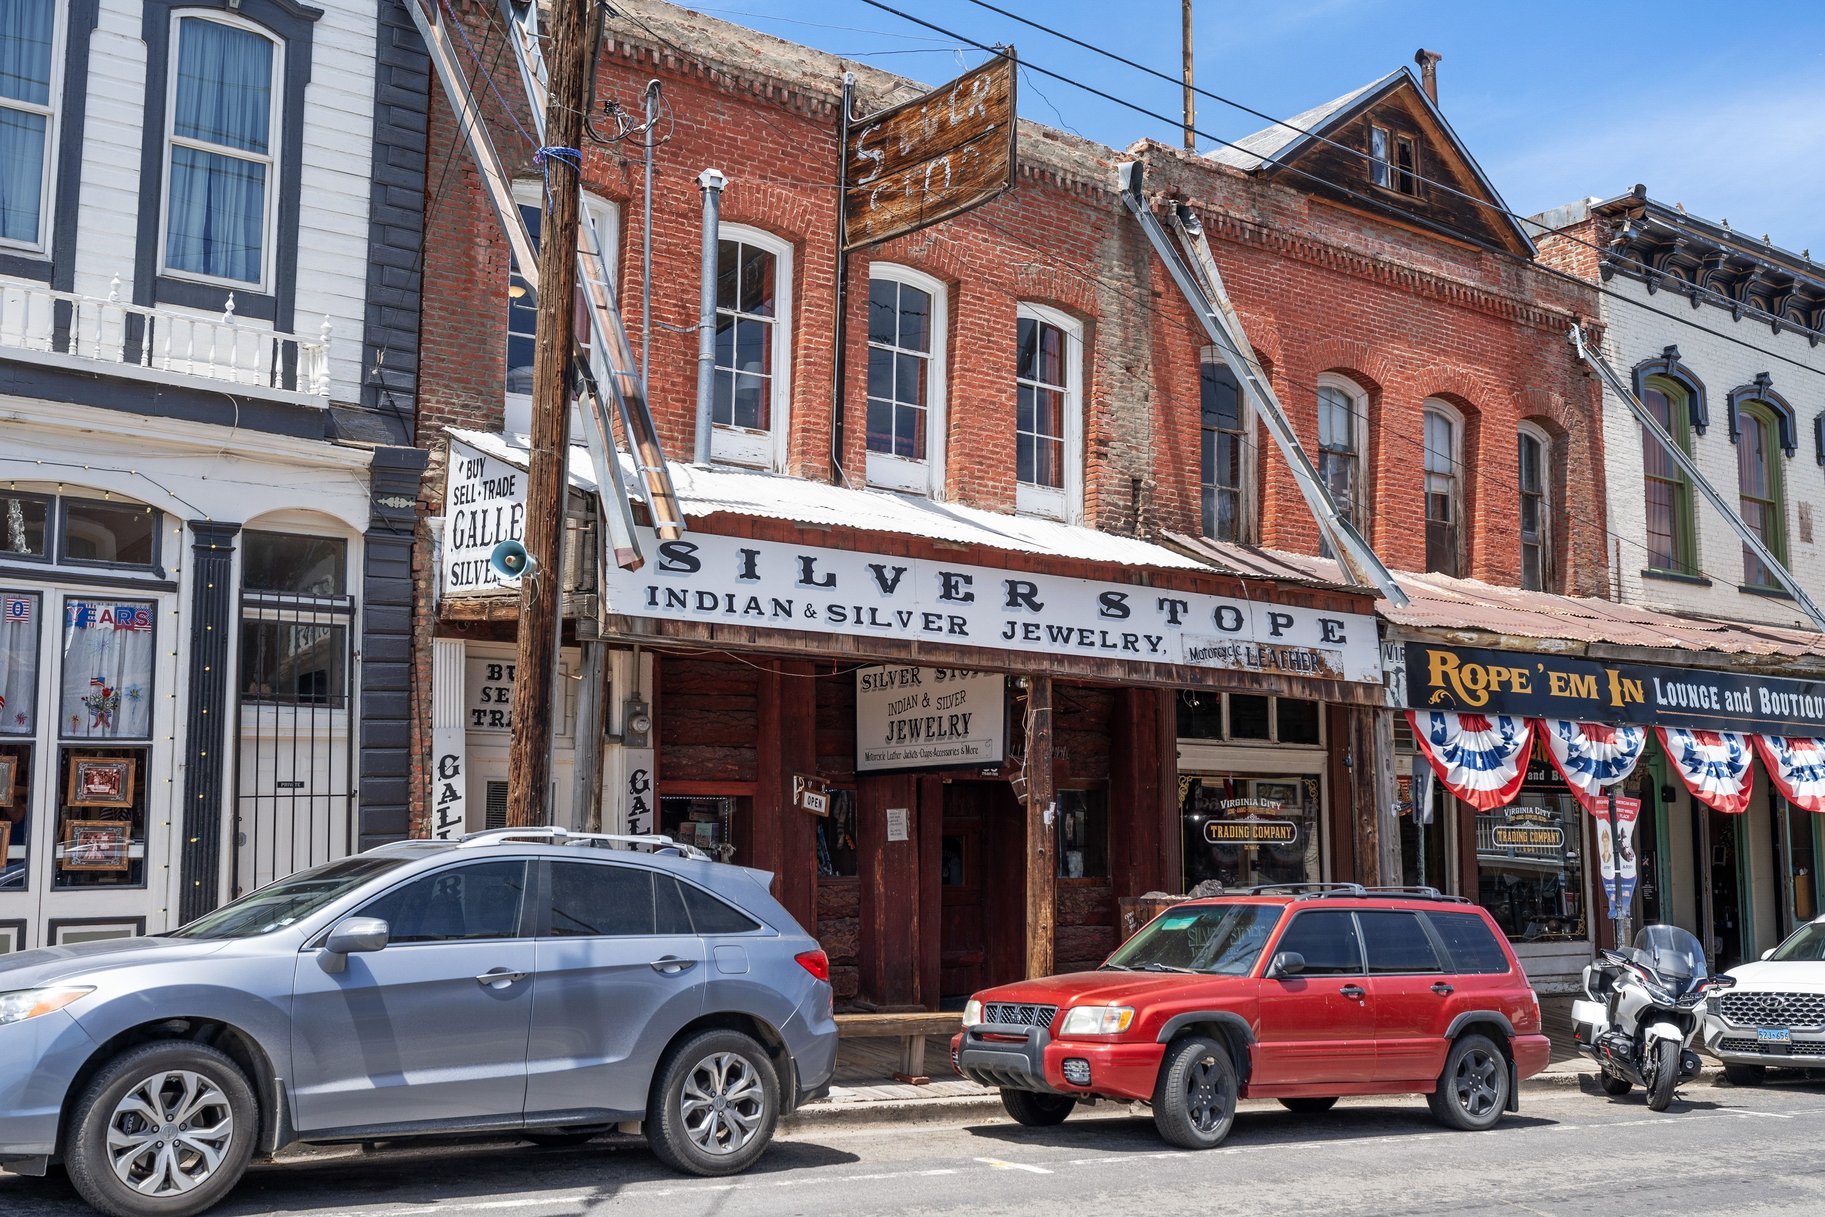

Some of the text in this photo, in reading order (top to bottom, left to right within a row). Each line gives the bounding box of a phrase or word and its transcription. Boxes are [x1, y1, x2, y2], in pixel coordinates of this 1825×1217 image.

[466, 457, 486, 480] BUY
[453, 475, 516, 506] SELL TRADE
[451, 502, 524, 552] GALLE
[450, 559, 498, 586] SILVE
[658, 540, 1347, 644] SILVER STOPE
[67, 605, 150, 626] YEARS
[647, 585, 1168, 655] INDIAN & SILVER JEWELRY,
[1189, 643, 1324, 675] Motorcycle LEATHER
[487, 663, 516, 682] BU
[862, 666, 922, 690] SILVER
[1426, 649, 1825, 719] ROPE 'EM IN LOUNGE and BOUTIQU
[481, 686, 510, 703] SE
[887, 689, 967, 717] INDIAN & SILVER
[886, 712, 973, 742] JEWELRY
[1527, 769, 1545, 780] and
[806, 795, 823, 809] OPEN
[1220, 797, 1282, 810] VIRGINIA CITY
[1504, 807, 1534, 817] VIRGINIA
[1535, 806, 1551, 818] CITY
[1210, 825, 1292, 839] TRADING COMPANY
[1496, 830, 1560, 843] TRADING COMPANY
